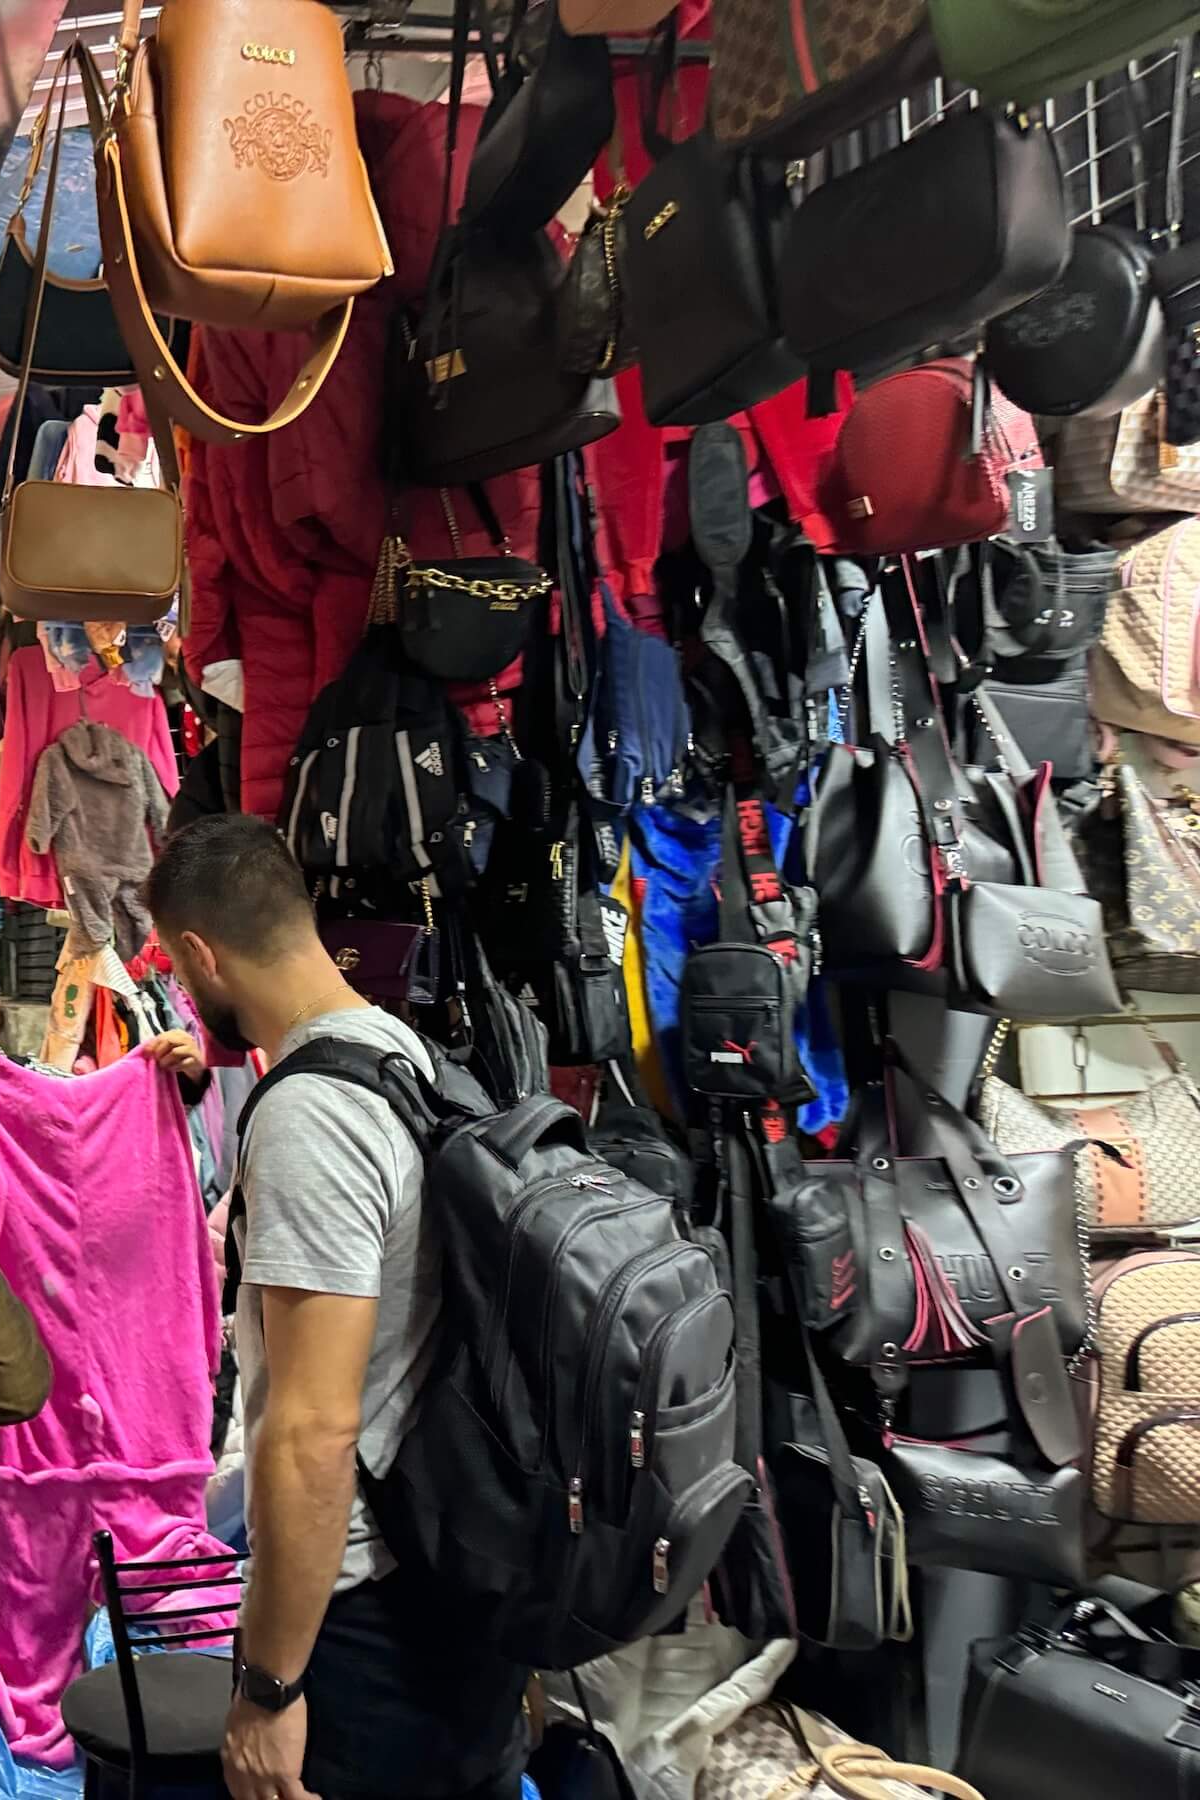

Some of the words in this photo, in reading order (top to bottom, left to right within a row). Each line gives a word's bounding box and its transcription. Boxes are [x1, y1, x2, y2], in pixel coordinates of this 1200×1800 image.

[243, 91, 312, 129] COLCCI
[1021, 482, 1036, 532] AREZZO
[600, 906, 628, 966] NIKE
